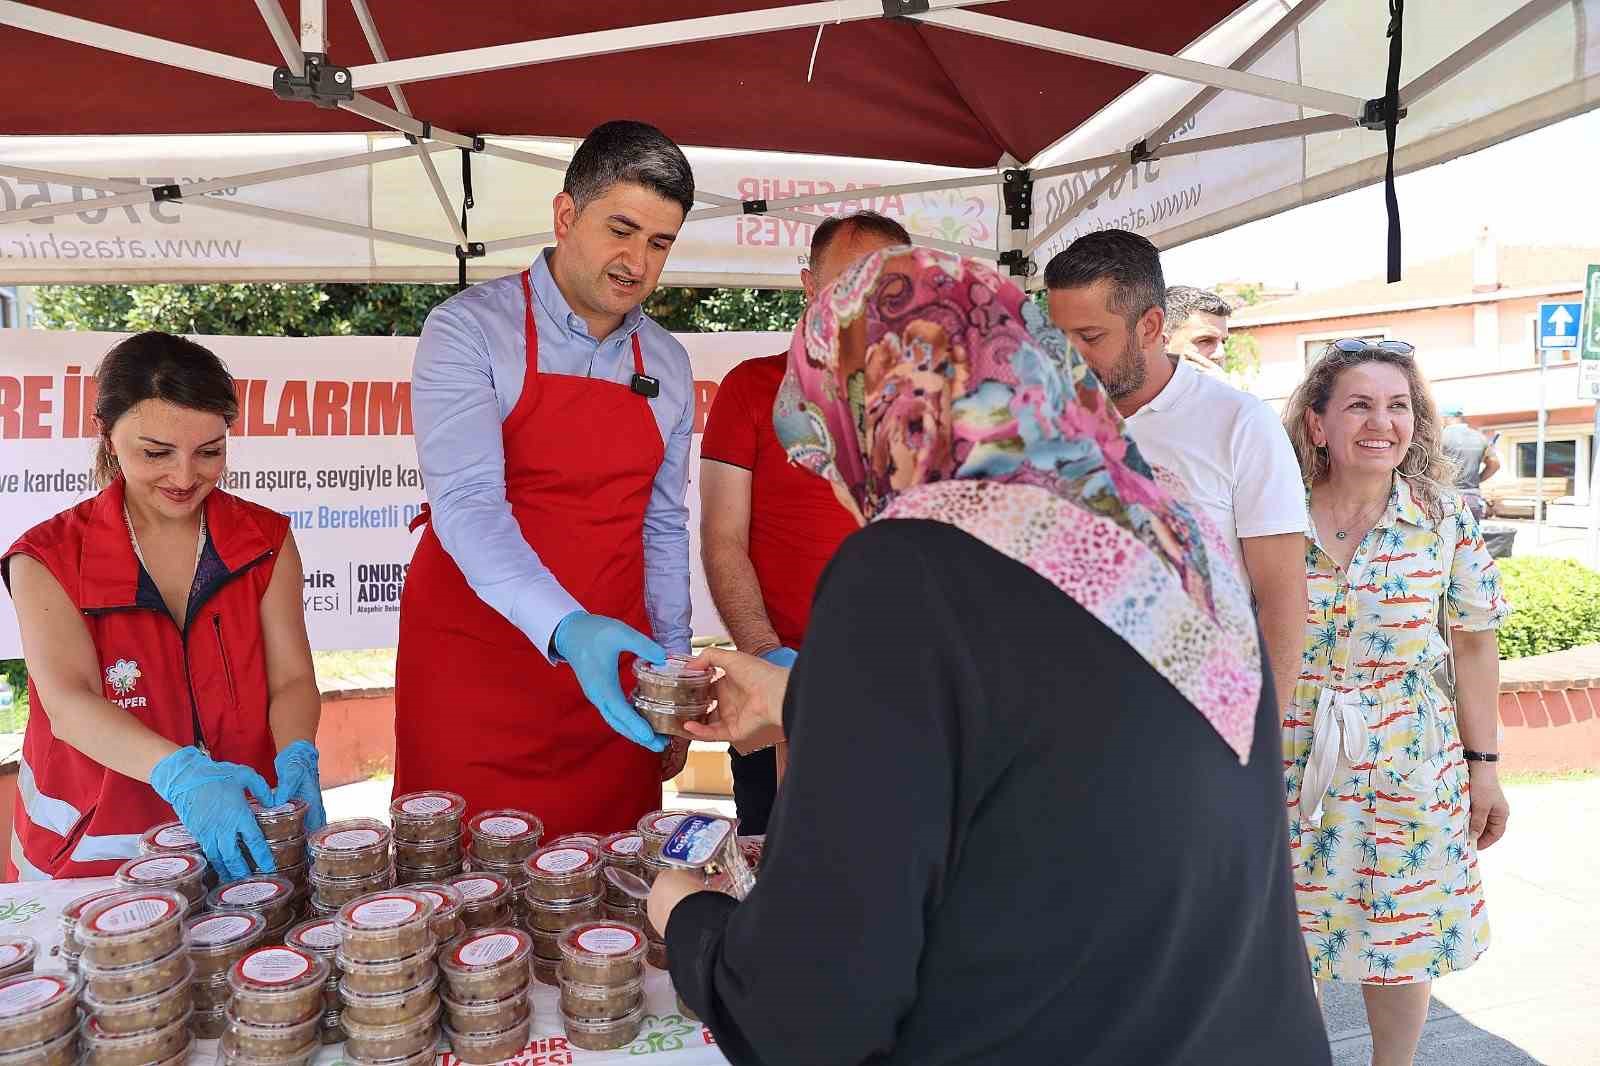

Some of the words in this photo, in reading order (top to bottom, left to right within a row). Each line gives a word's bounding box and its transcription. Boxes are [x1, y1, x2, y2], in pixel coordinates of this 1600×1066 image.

[24, 468, 99, 494] kardeşl
[255, 470, 311, 493] aşure,
[316, 465, 392, 491] sevgiyle
[318, 504, 398, 529] Bereketli
